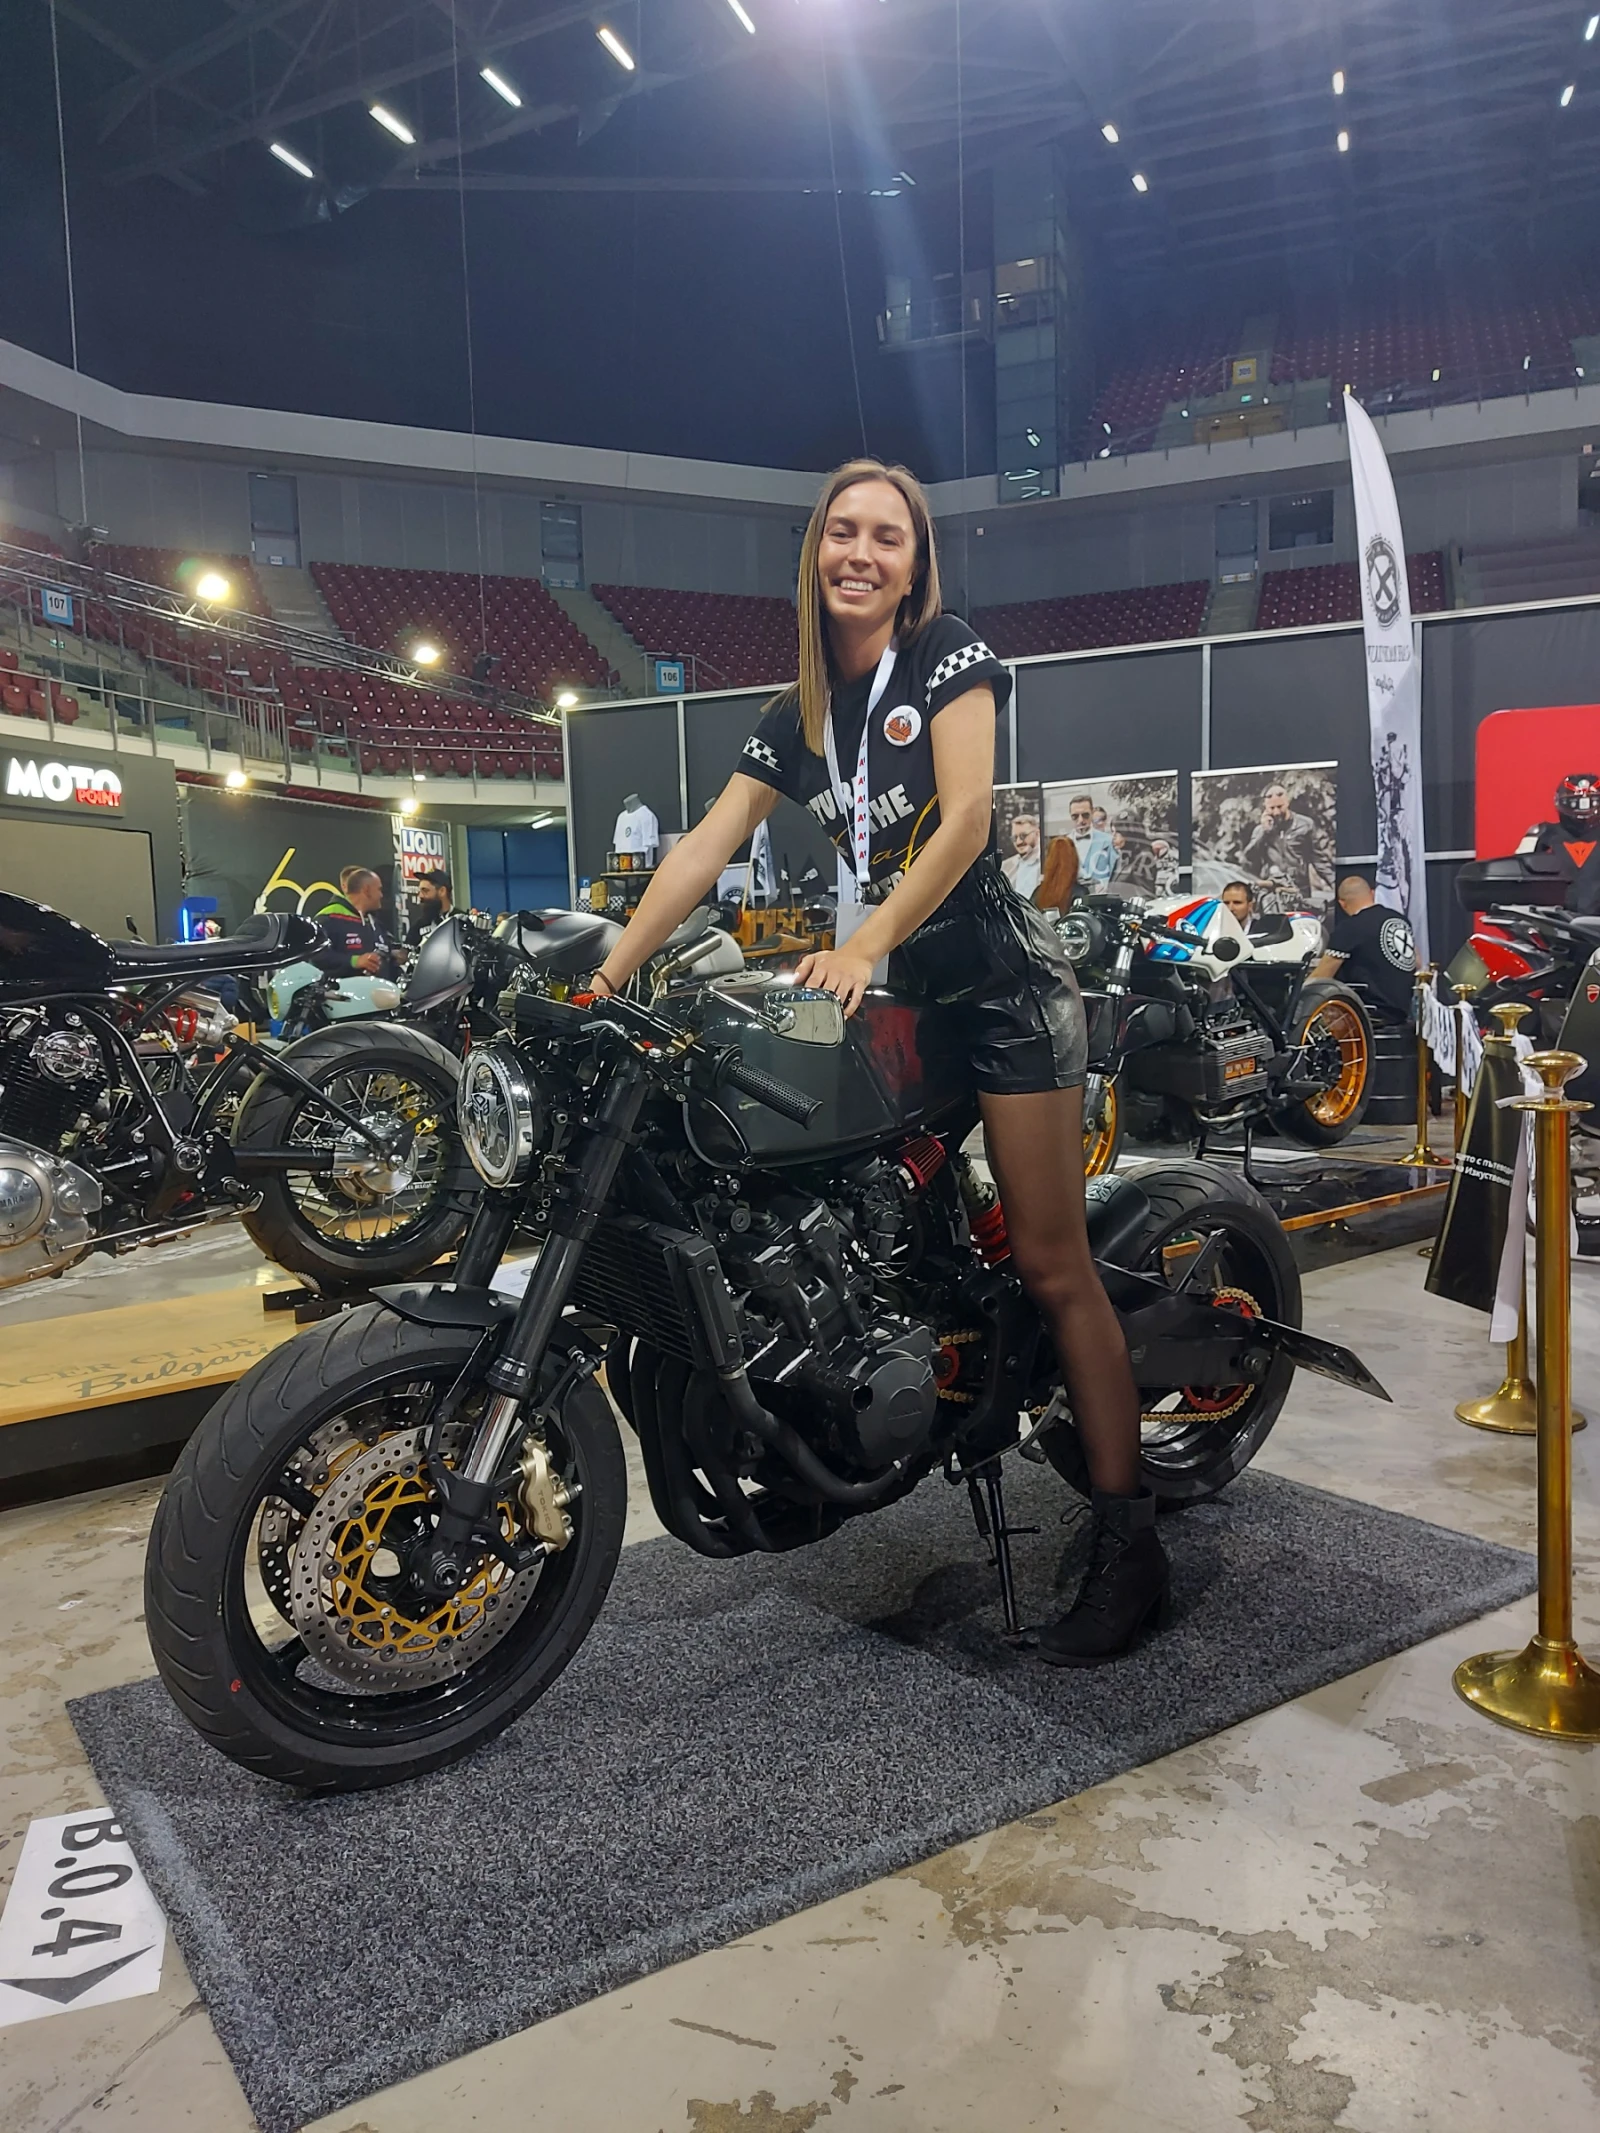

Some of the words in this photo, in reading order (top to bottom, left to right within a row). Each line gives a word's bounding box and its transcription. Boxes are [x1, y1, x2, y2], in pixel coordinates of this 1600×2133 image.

[49, 596, 65, 610] 107
[663, 672, 678, 681] 106
[6, 757, 122, 802] MOTO
[76, 788, 121, 807] POINT
[402, 829, 443, 856] LIQUI
[1090, 850, 1156, 881] CER
[130, 1338, 256, 1366] CLUB
[66, 1342, 283, 1399] Bulgari
[538, 1489, 553, 1532] TOKICO
